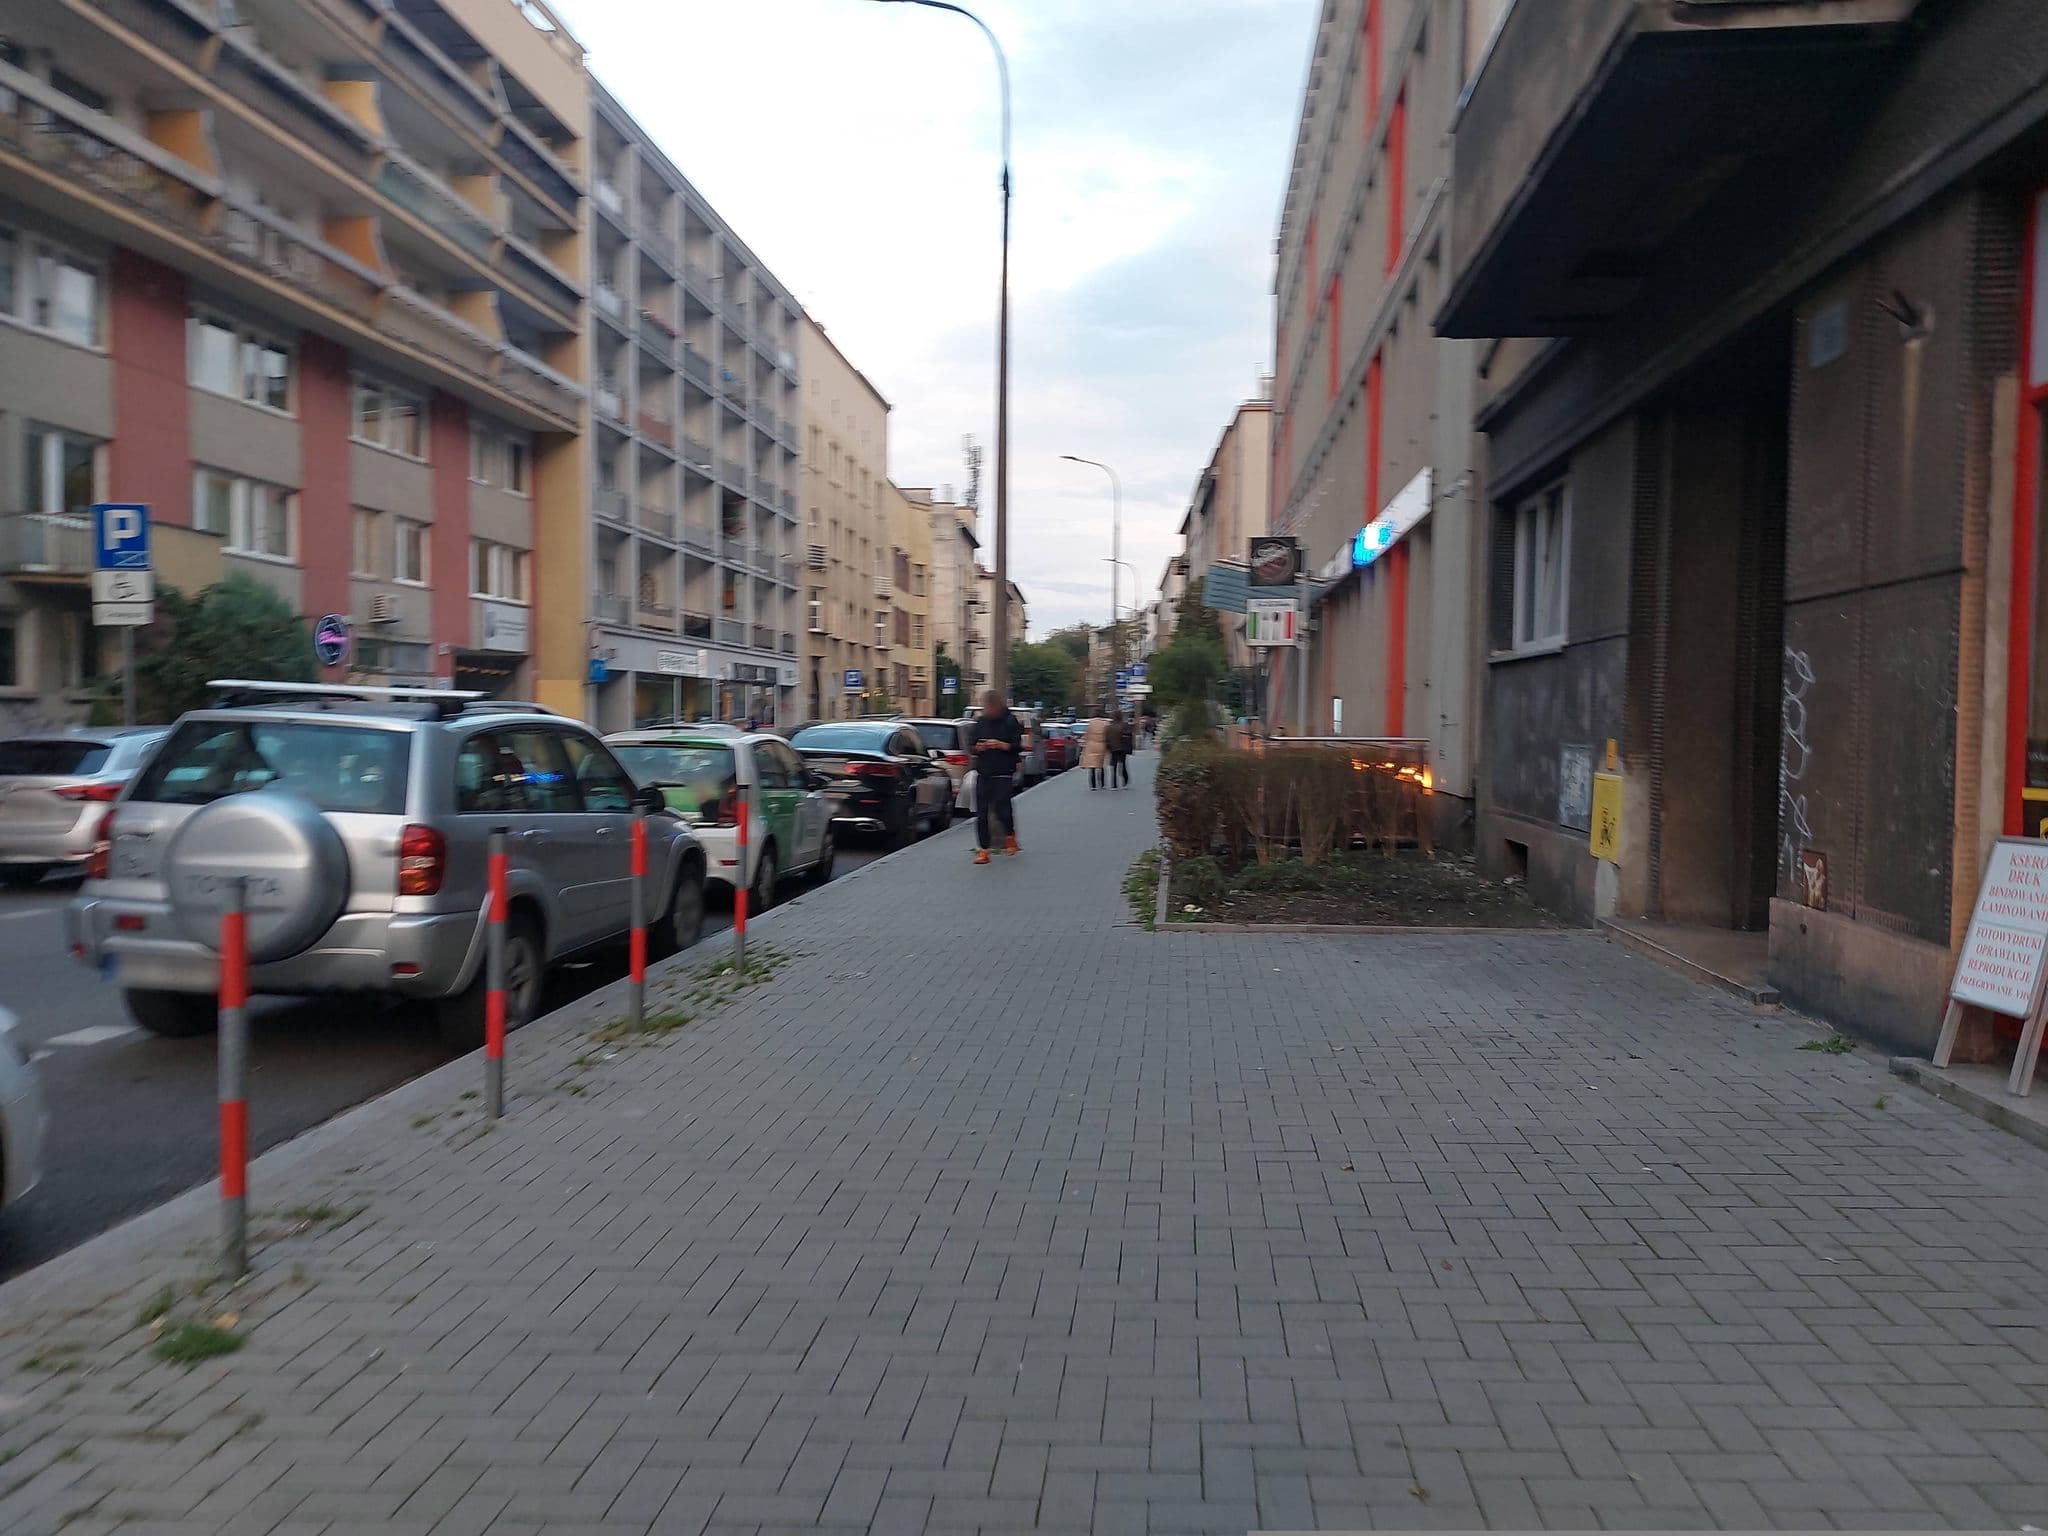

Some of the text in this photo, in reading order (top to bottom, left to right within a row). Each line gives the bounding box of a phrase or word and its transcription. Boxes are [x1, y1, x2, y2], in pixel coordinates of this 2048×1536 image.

[103, 508, 142, 551] P
[2009, 852, 2048, 870] KSERO
[184, 872, 282, 896] TOTA
[2008, 869, 2040, 887] DRUK
[1975, 926, 2042, 950] FOTOWYDRUKI
[1975, 943, 2032, 966] OPRAWIANIE
[1967, 957, 2032, 983] REPRODUKCJE
[1959, 975, 2014, 997] PRZEGRYWANIE
